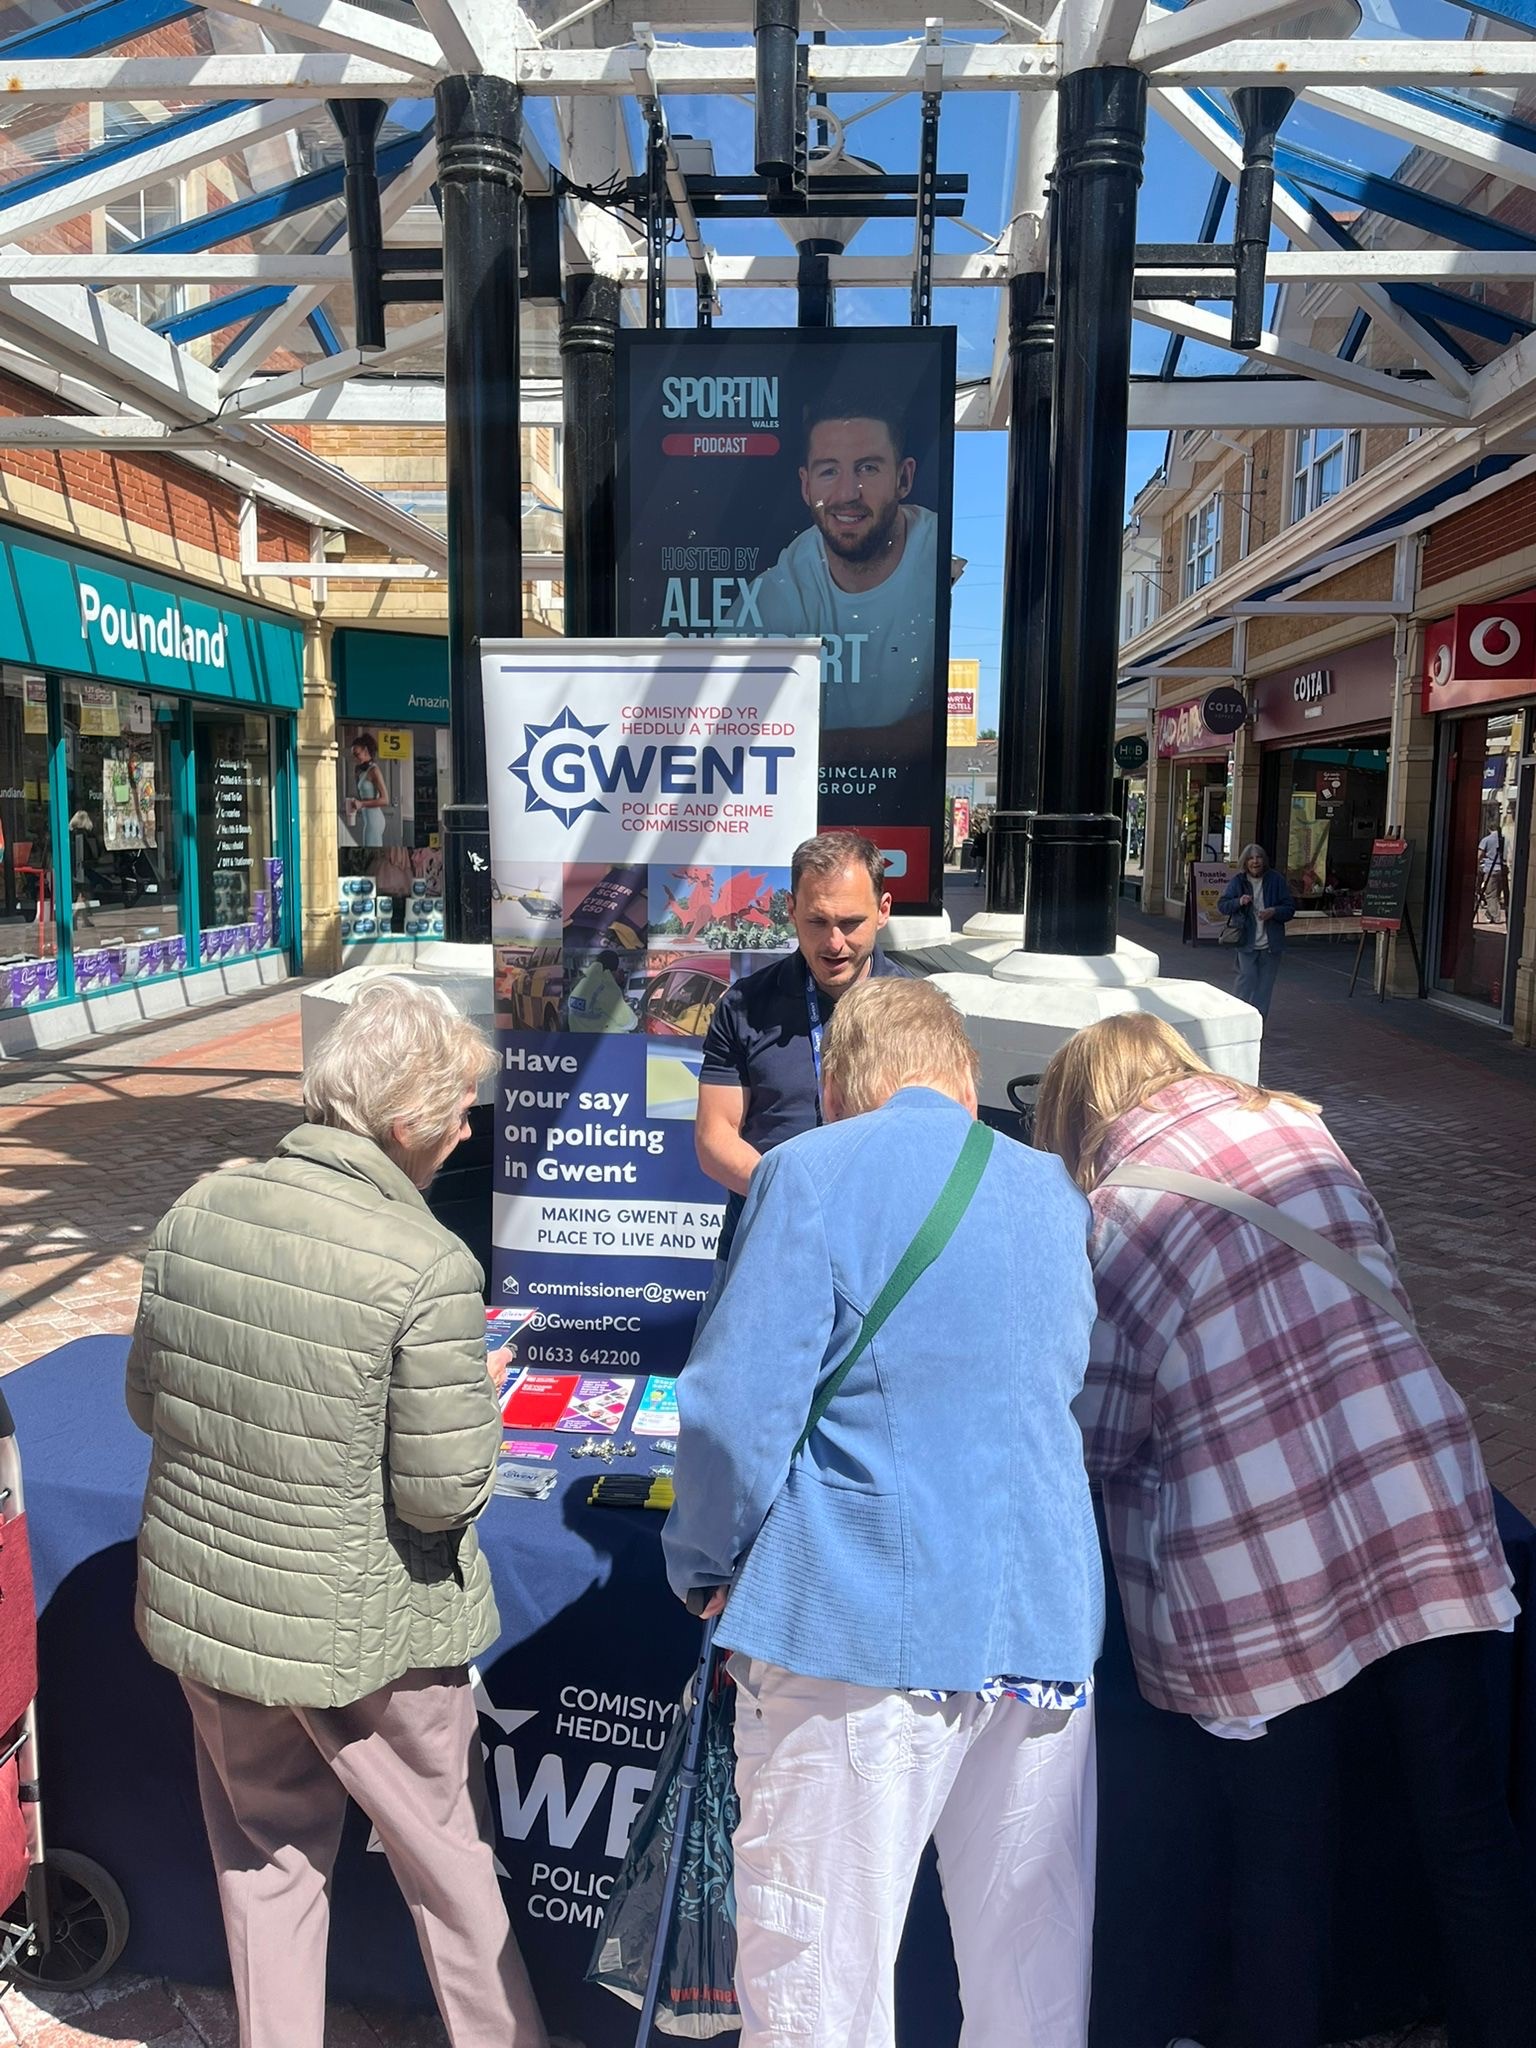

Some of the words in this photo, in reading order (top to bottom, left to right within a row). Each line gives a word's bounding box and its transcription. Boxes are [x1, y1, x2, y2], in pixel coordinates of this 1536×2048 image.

[662, 376, 778, 419] SPORTIN
[751, 420, 780, 428] WALES
[694, 437, 747, 453] PODCAST
[661, 546, 731, 571] HOSTED
[735, 547, 759, 571] BY
[661, 577, 764, 627] ALEX
[1293, 671, 1323, 701] COSTA
[408, 694, 450, 708] Amazin
[1209, 702, 1242, 713] COSTA
[621, 706, 732, 719] COMISIYNYDD
[737, 706, 758, 719] YR
[621, 722, 685, 736] HEDDLU
[689, 722, 701, 735] A
[707, 723, 795, 736] THROSEDD
[384, 734, 401, 751] £5
[541, 743, 796, 795] GWENT
[818, 766, 897, 779] SINCLAIR
[0, 786, 25, 799] undland
[818, 782, 877, 794] GROUP
[622, 802, 678, 816] POLICE
[683, 803, 718, 816] AND
[723, 804, 773, 817] CRIME
[621, 819, 749, 833] COMMISSIONER
[505, 1047, 578, 1073] Have
[504, 1088, 570, 1112] your
[579, 1091, 629, 1117] say
[504, 1124, 537, 1143] on
[547, 1123, 665, 1154] policing
[504, 1155, 528, 1179] in
[536, 1158, 637, 1183] Gwent
[542, 1207, 611, 1223] MAKING
[617, 1209, 678, 1225] GWENT
[683, 1212, 695, 1226] A
[700, 1213, 725, 1228] SA
[538, 1229, 587, 1245] PLACE
[593, 1231, 616, 1246] TO
[622, 1232, 654, 1247] LIVE
[660, 1234, 696, 1249] AND
[701, 1236, 719, 1251] W
[528, 1281, 709, 1304] commissioner@gwen
[528, 1312, 641, 1332] @GwentPCC
[527, 1345, 574, 1363] 01633
[579, 1349, 640, 1366] 642200
[555, 1713, 666, 1751] HEDDLU
[531, 1862, 615, 1900] POLIC
